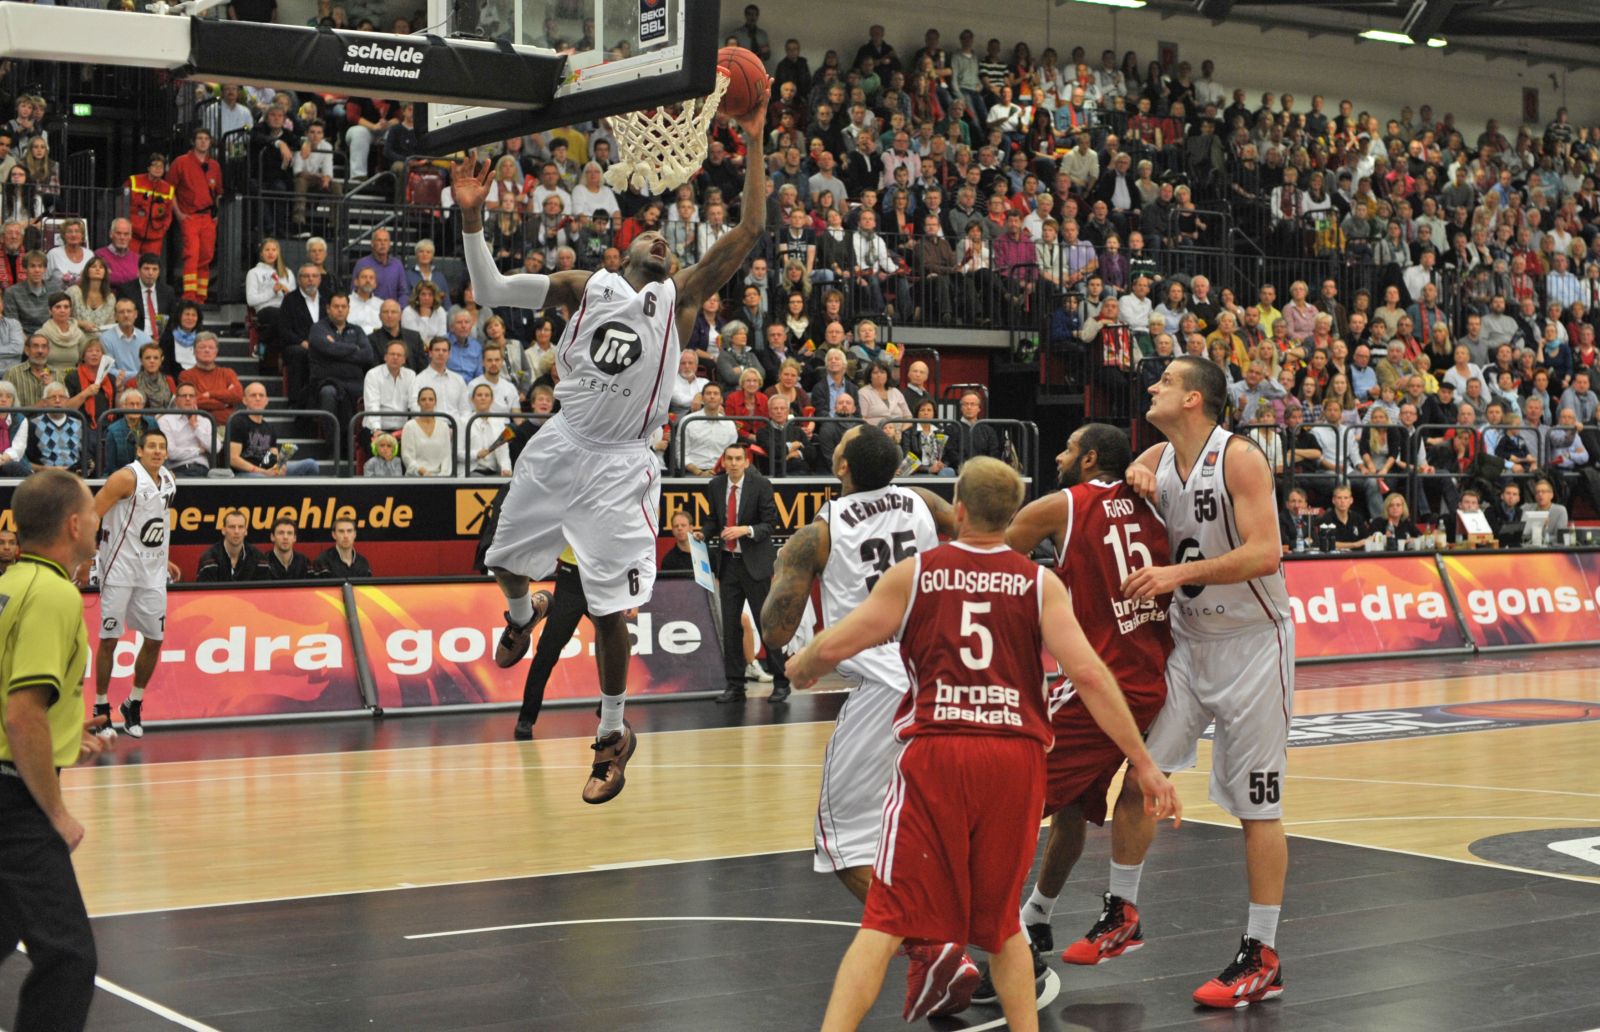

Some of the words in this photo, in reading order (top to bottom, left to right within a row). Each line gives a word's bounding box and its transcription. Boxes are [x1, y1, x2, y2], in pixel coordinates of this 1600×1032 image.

[641, 20, 665, 35] BBL
[347, 43, 424, 64] schelde
[343, 61, 420, 79] international
[642, 291, 657, 318] 6
[578, 378, 632, 397] MECO
[1194, 488, 1218, 523] 55
[1103, 523, 1153, 585] 15
[627, 568, 640, 596] 6
[921, 568, 1034, 596] GOLDSBERRY
[1111, 597, 1159, 618] bros
[1466, 584, 1600, 625] gons.
[959, 600, 993, 670] 5
[1118, 609, 1166, 635] baskets
[934, 679, 1020, 707] brose
[933, 702, 1023, 727] baskets
[1249, 771, 1280, 805] 55
